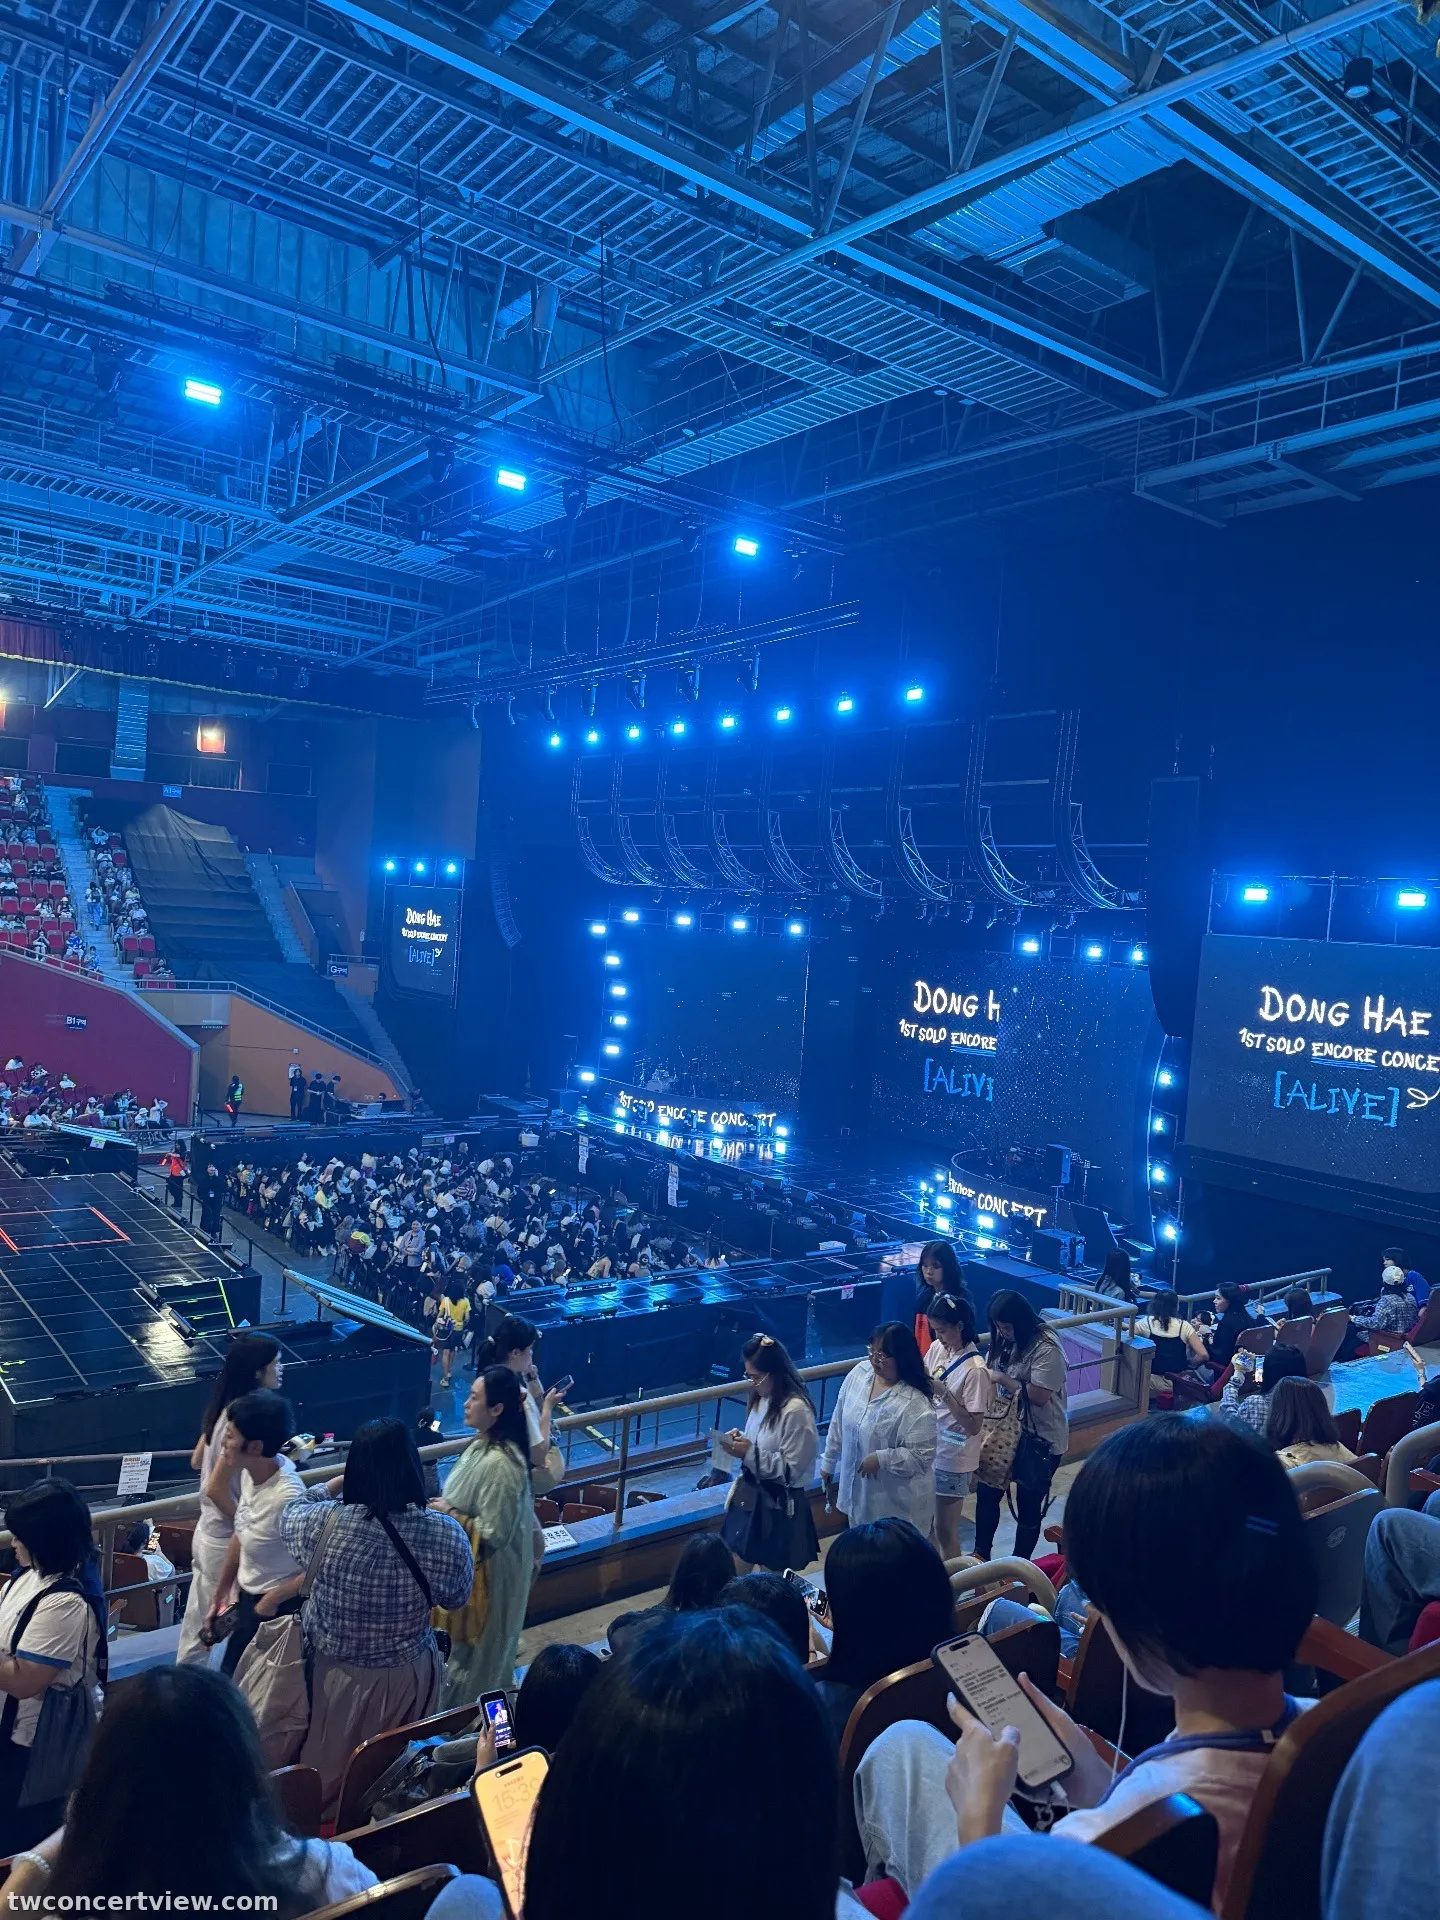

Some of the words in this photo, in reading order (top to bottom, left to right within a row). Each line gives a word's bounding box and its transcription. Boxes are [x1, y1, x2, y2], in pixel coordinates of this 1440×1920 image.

[406, 907, 426, 925] DONG
[427, 909, 442, 927] HAE
[409, 945, 434, 967] [ALIVE]
[913, 980, 979, 1018] DONG
[1259, 985, 1350, 1027] DONG
[1363, 995, 1432, 1037] HAE
[899, 1018, 919, 1038] 1ST
[918, 1027, 947, 1044] SOLO
[950, 1032, 998, 1050] ENCORE
[1238, 1027, 1266, 1049] 1ST
[1266, 1036, 1306, 1055] SOLO
[1311, 1042, 1378, 1064] ENCORE
[1381, 1050, 1440, 1073] CONCE
[618, 1090, 633, 1109] 1ST
[1273, 1070, 1400, 1128] [ALIVE]
